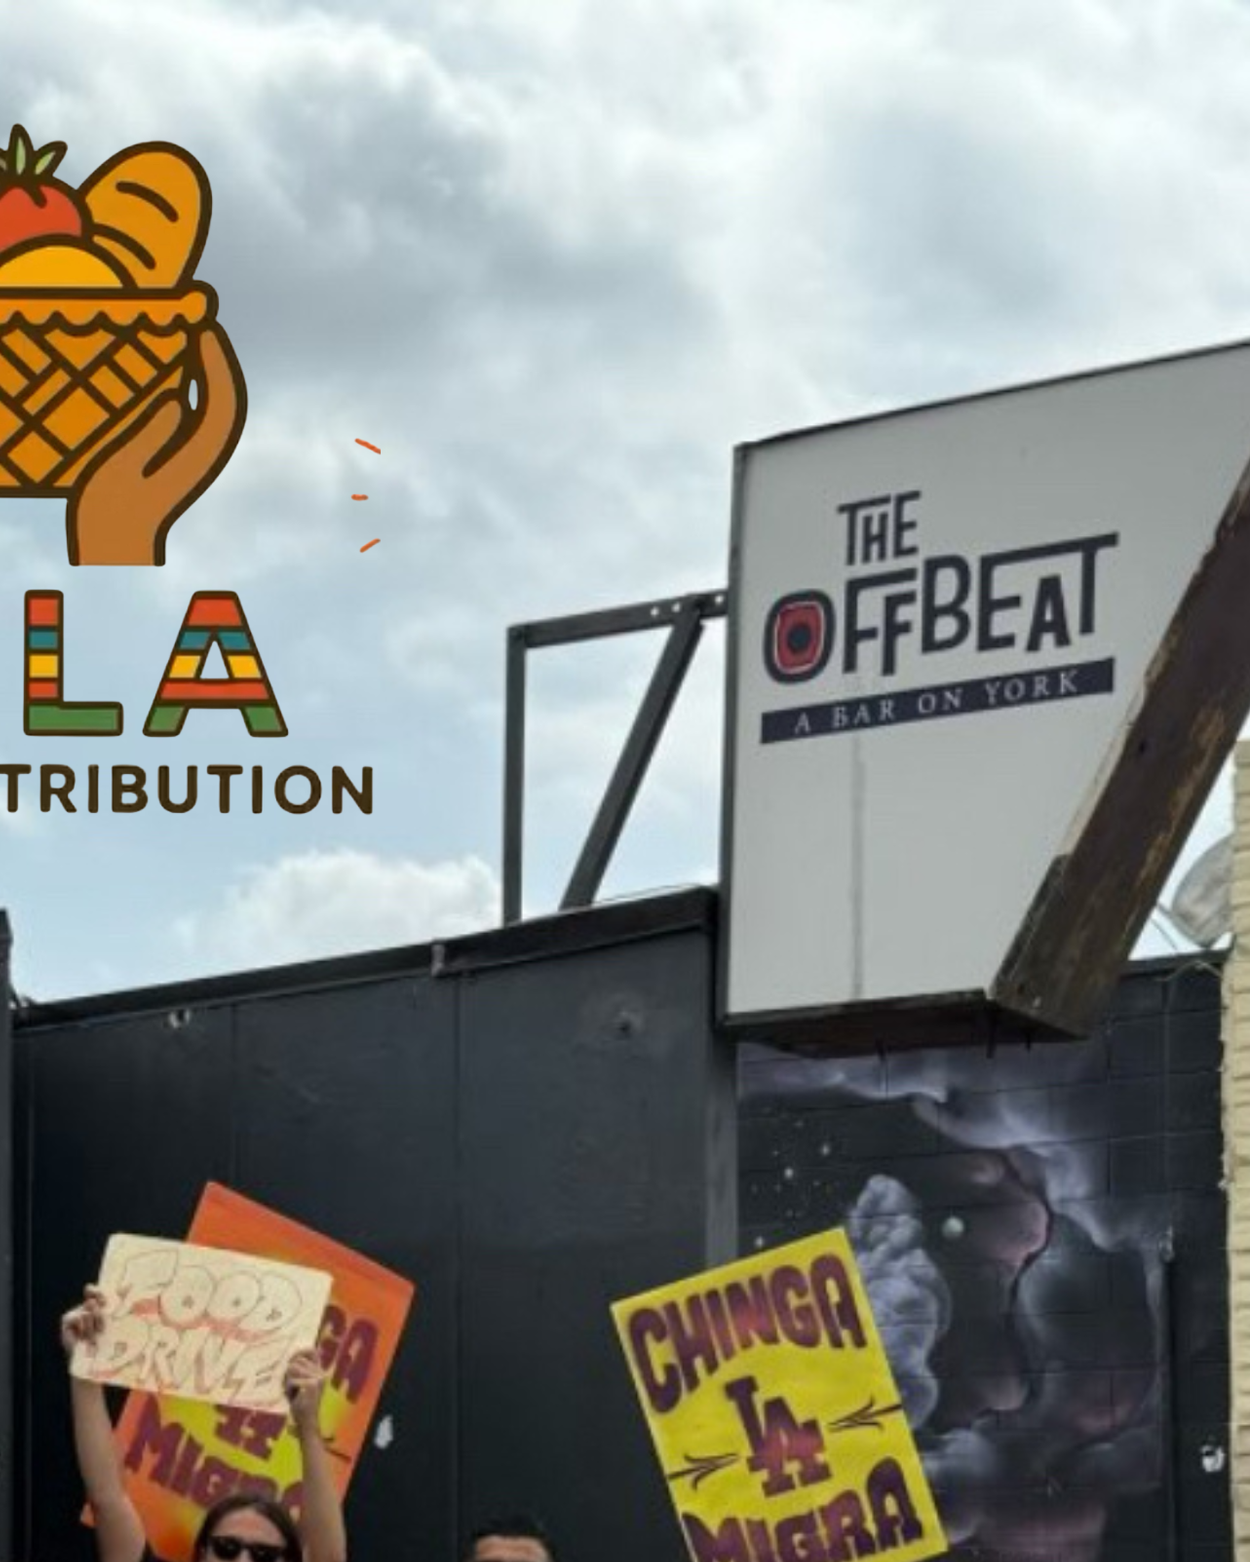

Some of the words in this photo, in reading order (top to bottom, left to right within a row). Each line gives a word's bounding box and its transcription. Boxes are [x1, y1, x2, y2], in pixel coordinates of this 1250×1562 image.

[837, 490, 921, 566] THE
[764, 531, 1119, 684] OFFBEAT
[794, 713, 812, 735] A
[831, 702, 897, 730] BAR
[917, 687, 964, 716] ON
[985, 670, 1079, 707] YORK
[111, 1249, 303, 1339] FOOD
[628, 1253, 868, 1414] CHINGA
[92, 1316, 299, 1404] DRIVE
[723, 1375, 832, 1497] LA
